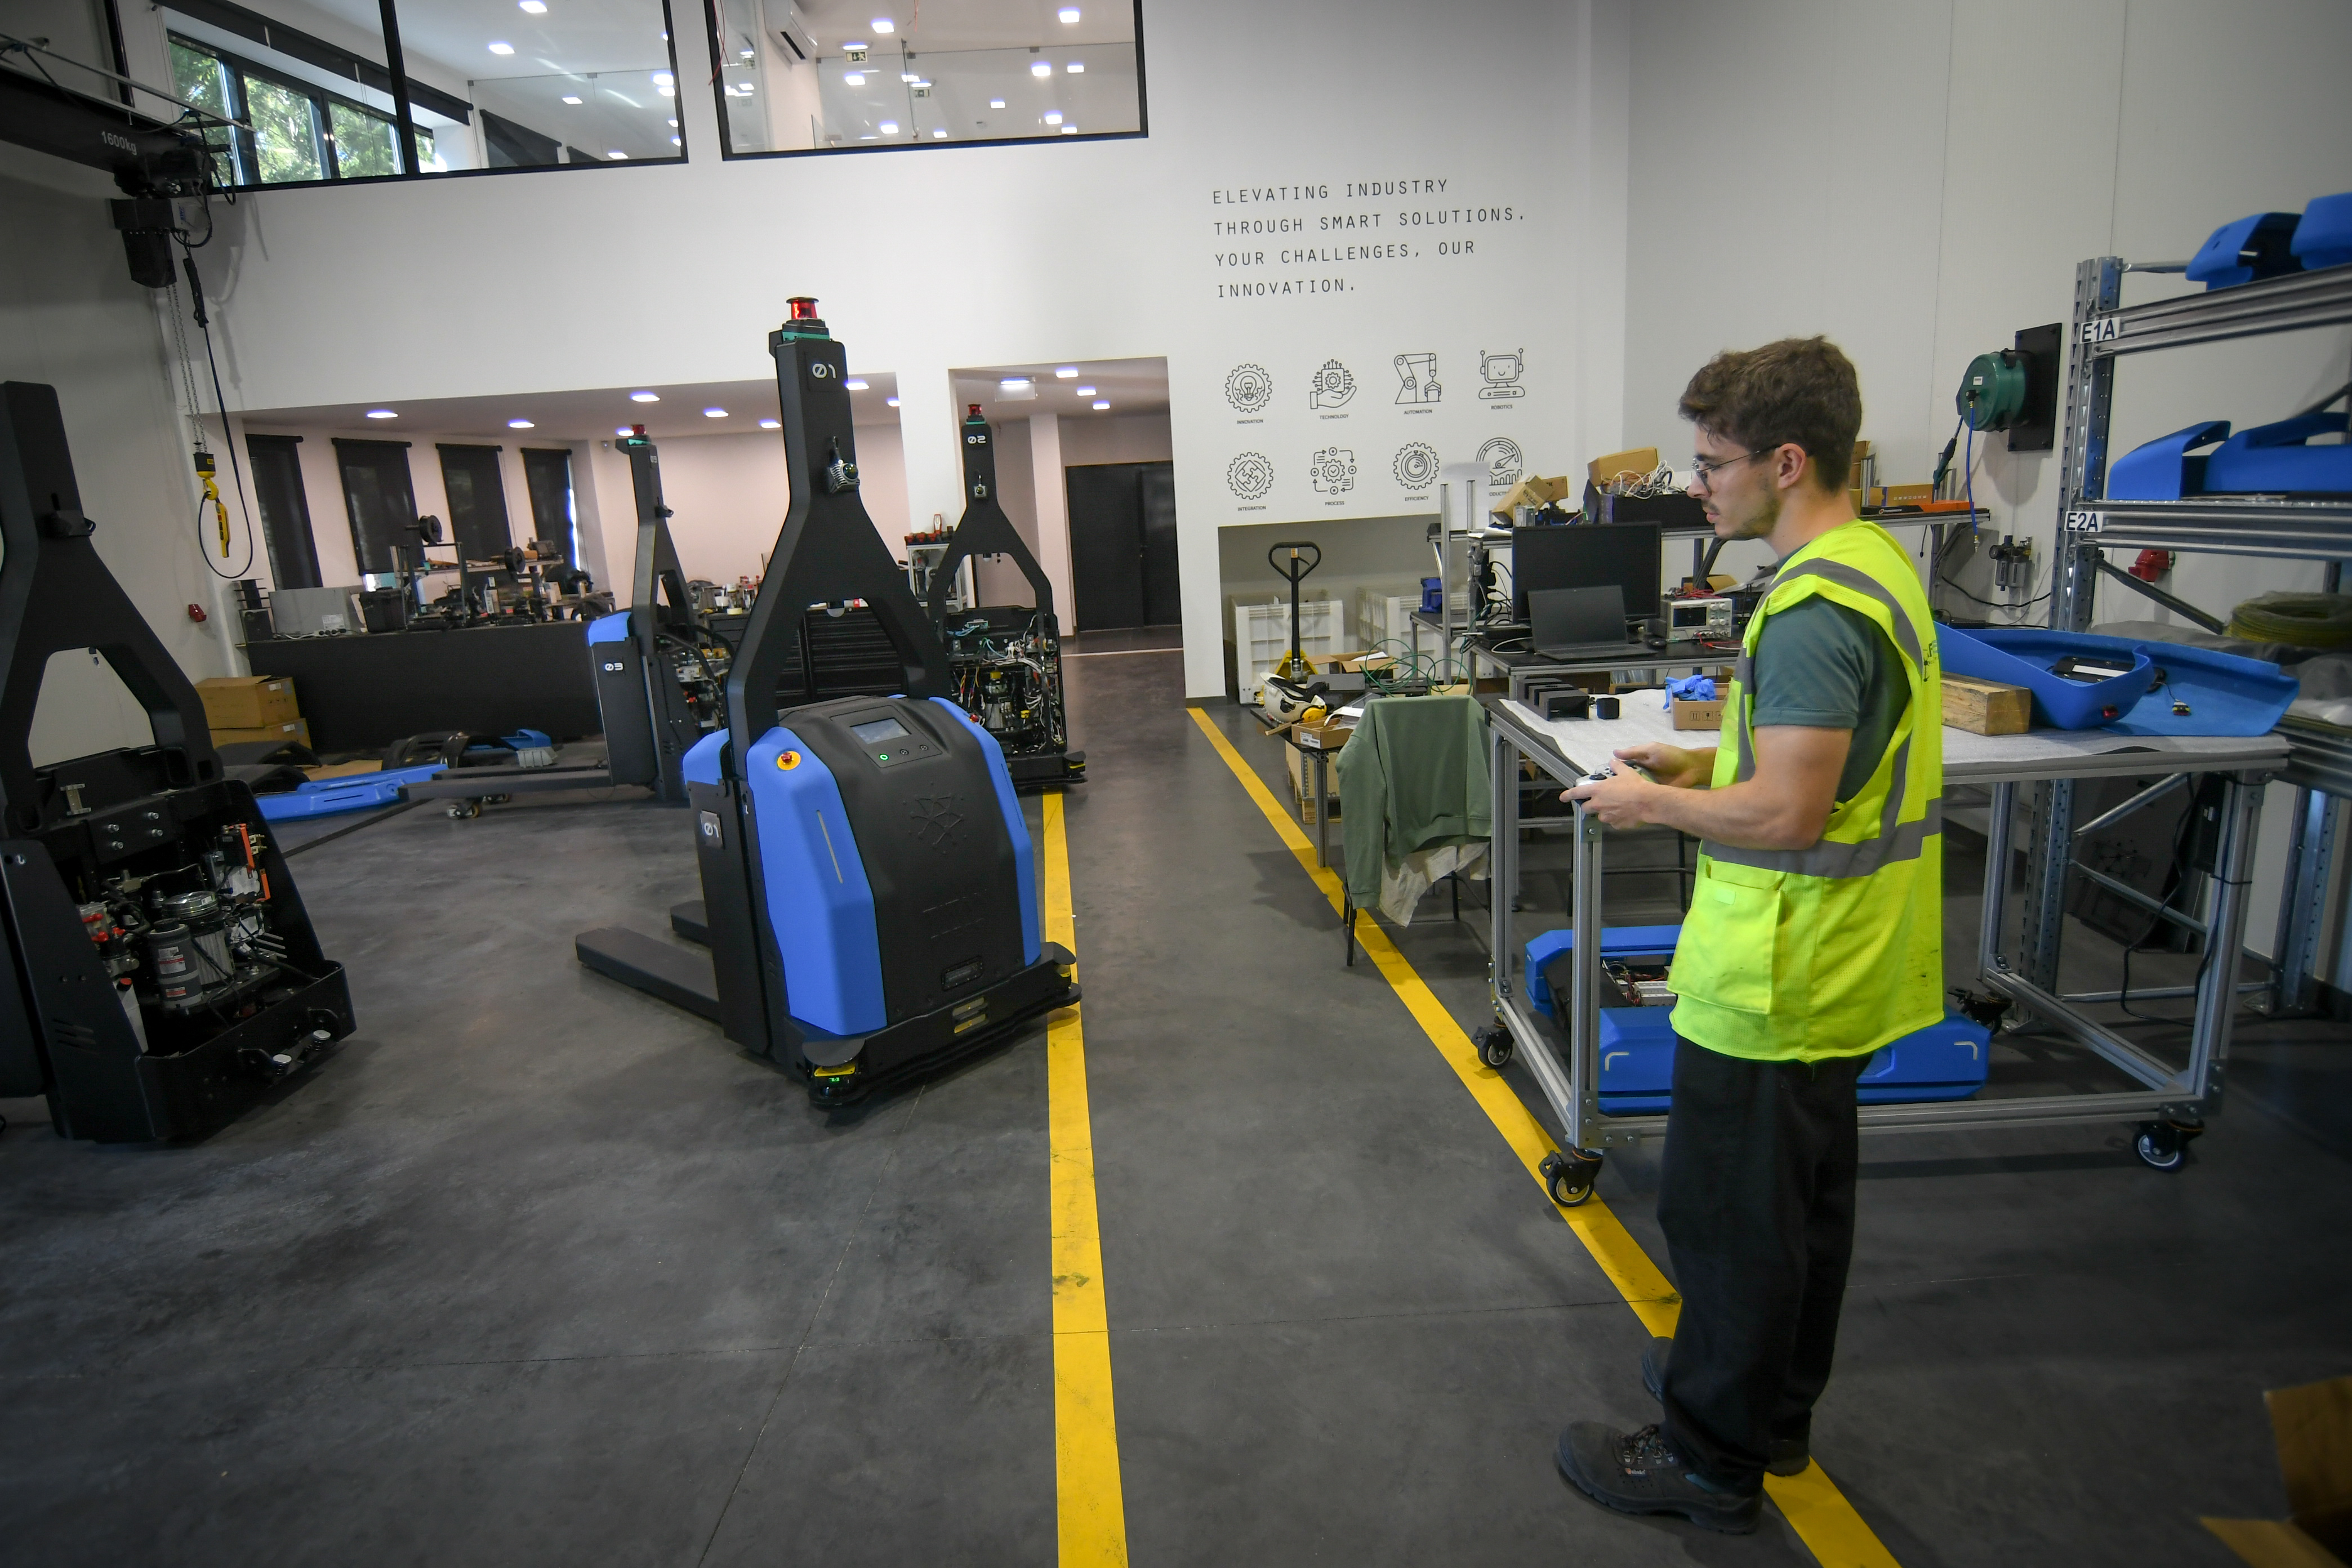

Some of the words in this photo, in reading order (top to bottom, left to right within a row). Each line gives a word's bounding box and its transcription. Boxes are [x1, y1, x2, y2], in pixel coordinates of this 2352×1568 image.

[101, 131, 137, 155] 1600kg
[1213, 185, 1328, 204] ELEVATING
[1347, 179, 1447, 197] INDUSTRY
[1214, 218, 1303, 235] THROUGH
[1320, 213, 1381, 230] SMART
[1399, 207, 1524, 226] SOLUTIONS.
[1215, 252, 1264, 267] YOUR
[1281, 243, 1419, 263] CHALLENGES,
[1438, 240, 1475, 255] OUR
[1218, 278, 1355, 298] INNOVATION.
[2082, 319, 2114, 342] E1A
[812, 363, 836, 379] 01
[967, 435, 986, 444] 02
[2066, 513, 2099, 532] E2A
[604, 662, 623, 671] 03
